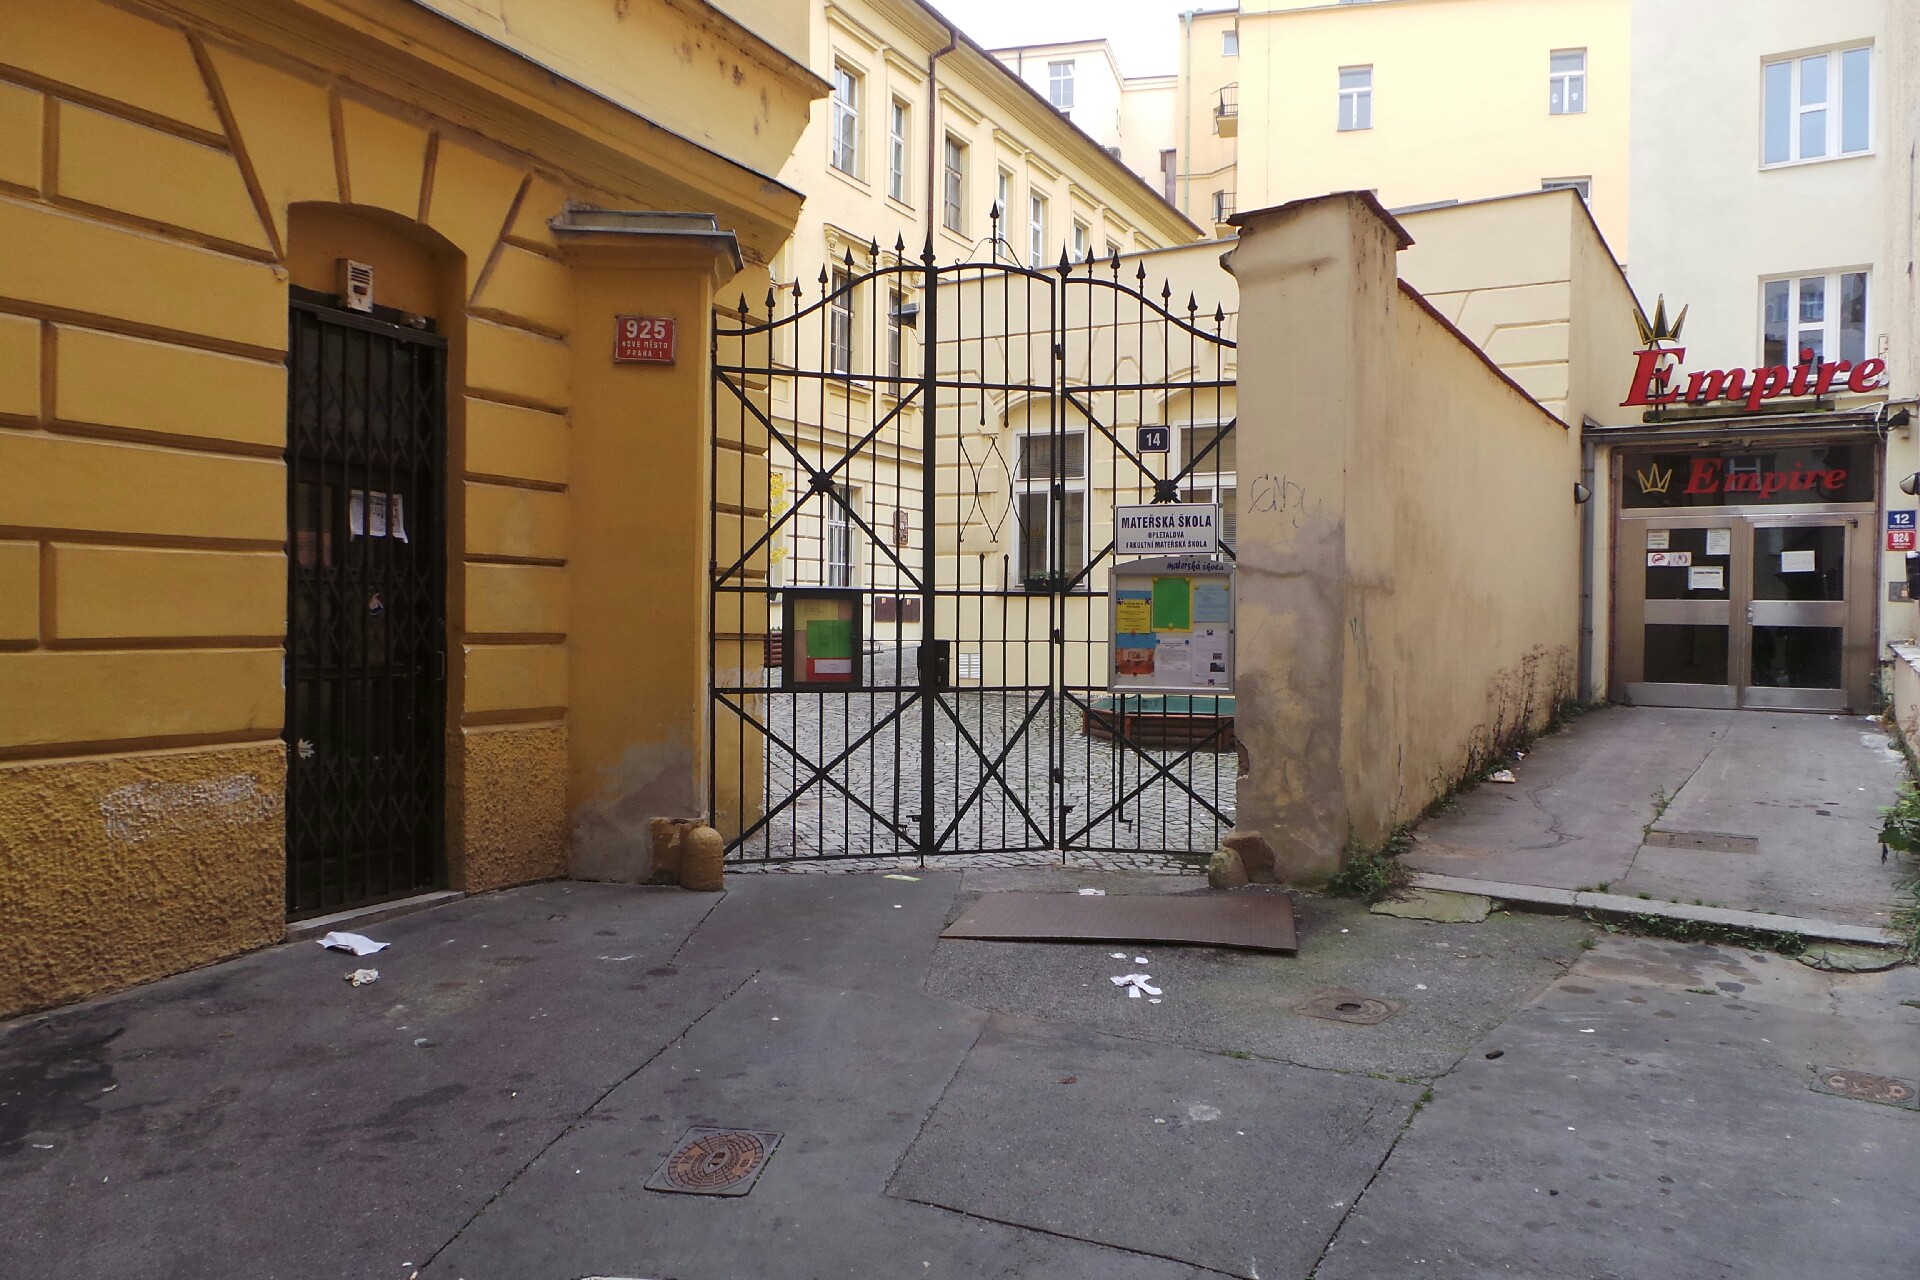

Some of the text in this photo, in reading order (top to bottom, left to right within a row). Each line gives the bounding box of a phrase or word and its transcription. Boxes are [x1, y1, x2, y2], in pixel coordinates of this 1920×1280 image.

[626, 320, 666, 339] 925
[627, 350, 652, 358] PRAHA
[1619, 347, 1886, 411] Empire
[1146, 432, 1161, 447] 14
[1683, 457, 1848, 500] Empire
[1121, 513, 1212, 529] MATEŘSKÁ ŠKOLA
[1894, 513, 1910, 524] 12
[1148, 531, 1184, 539] OPLETALOVA
[1893, 533, 1909, 543] 924
[1126, 540, 1154, 549] FAKULTNÍ
[1188, 539, 1208, 548] ŠKOLA
